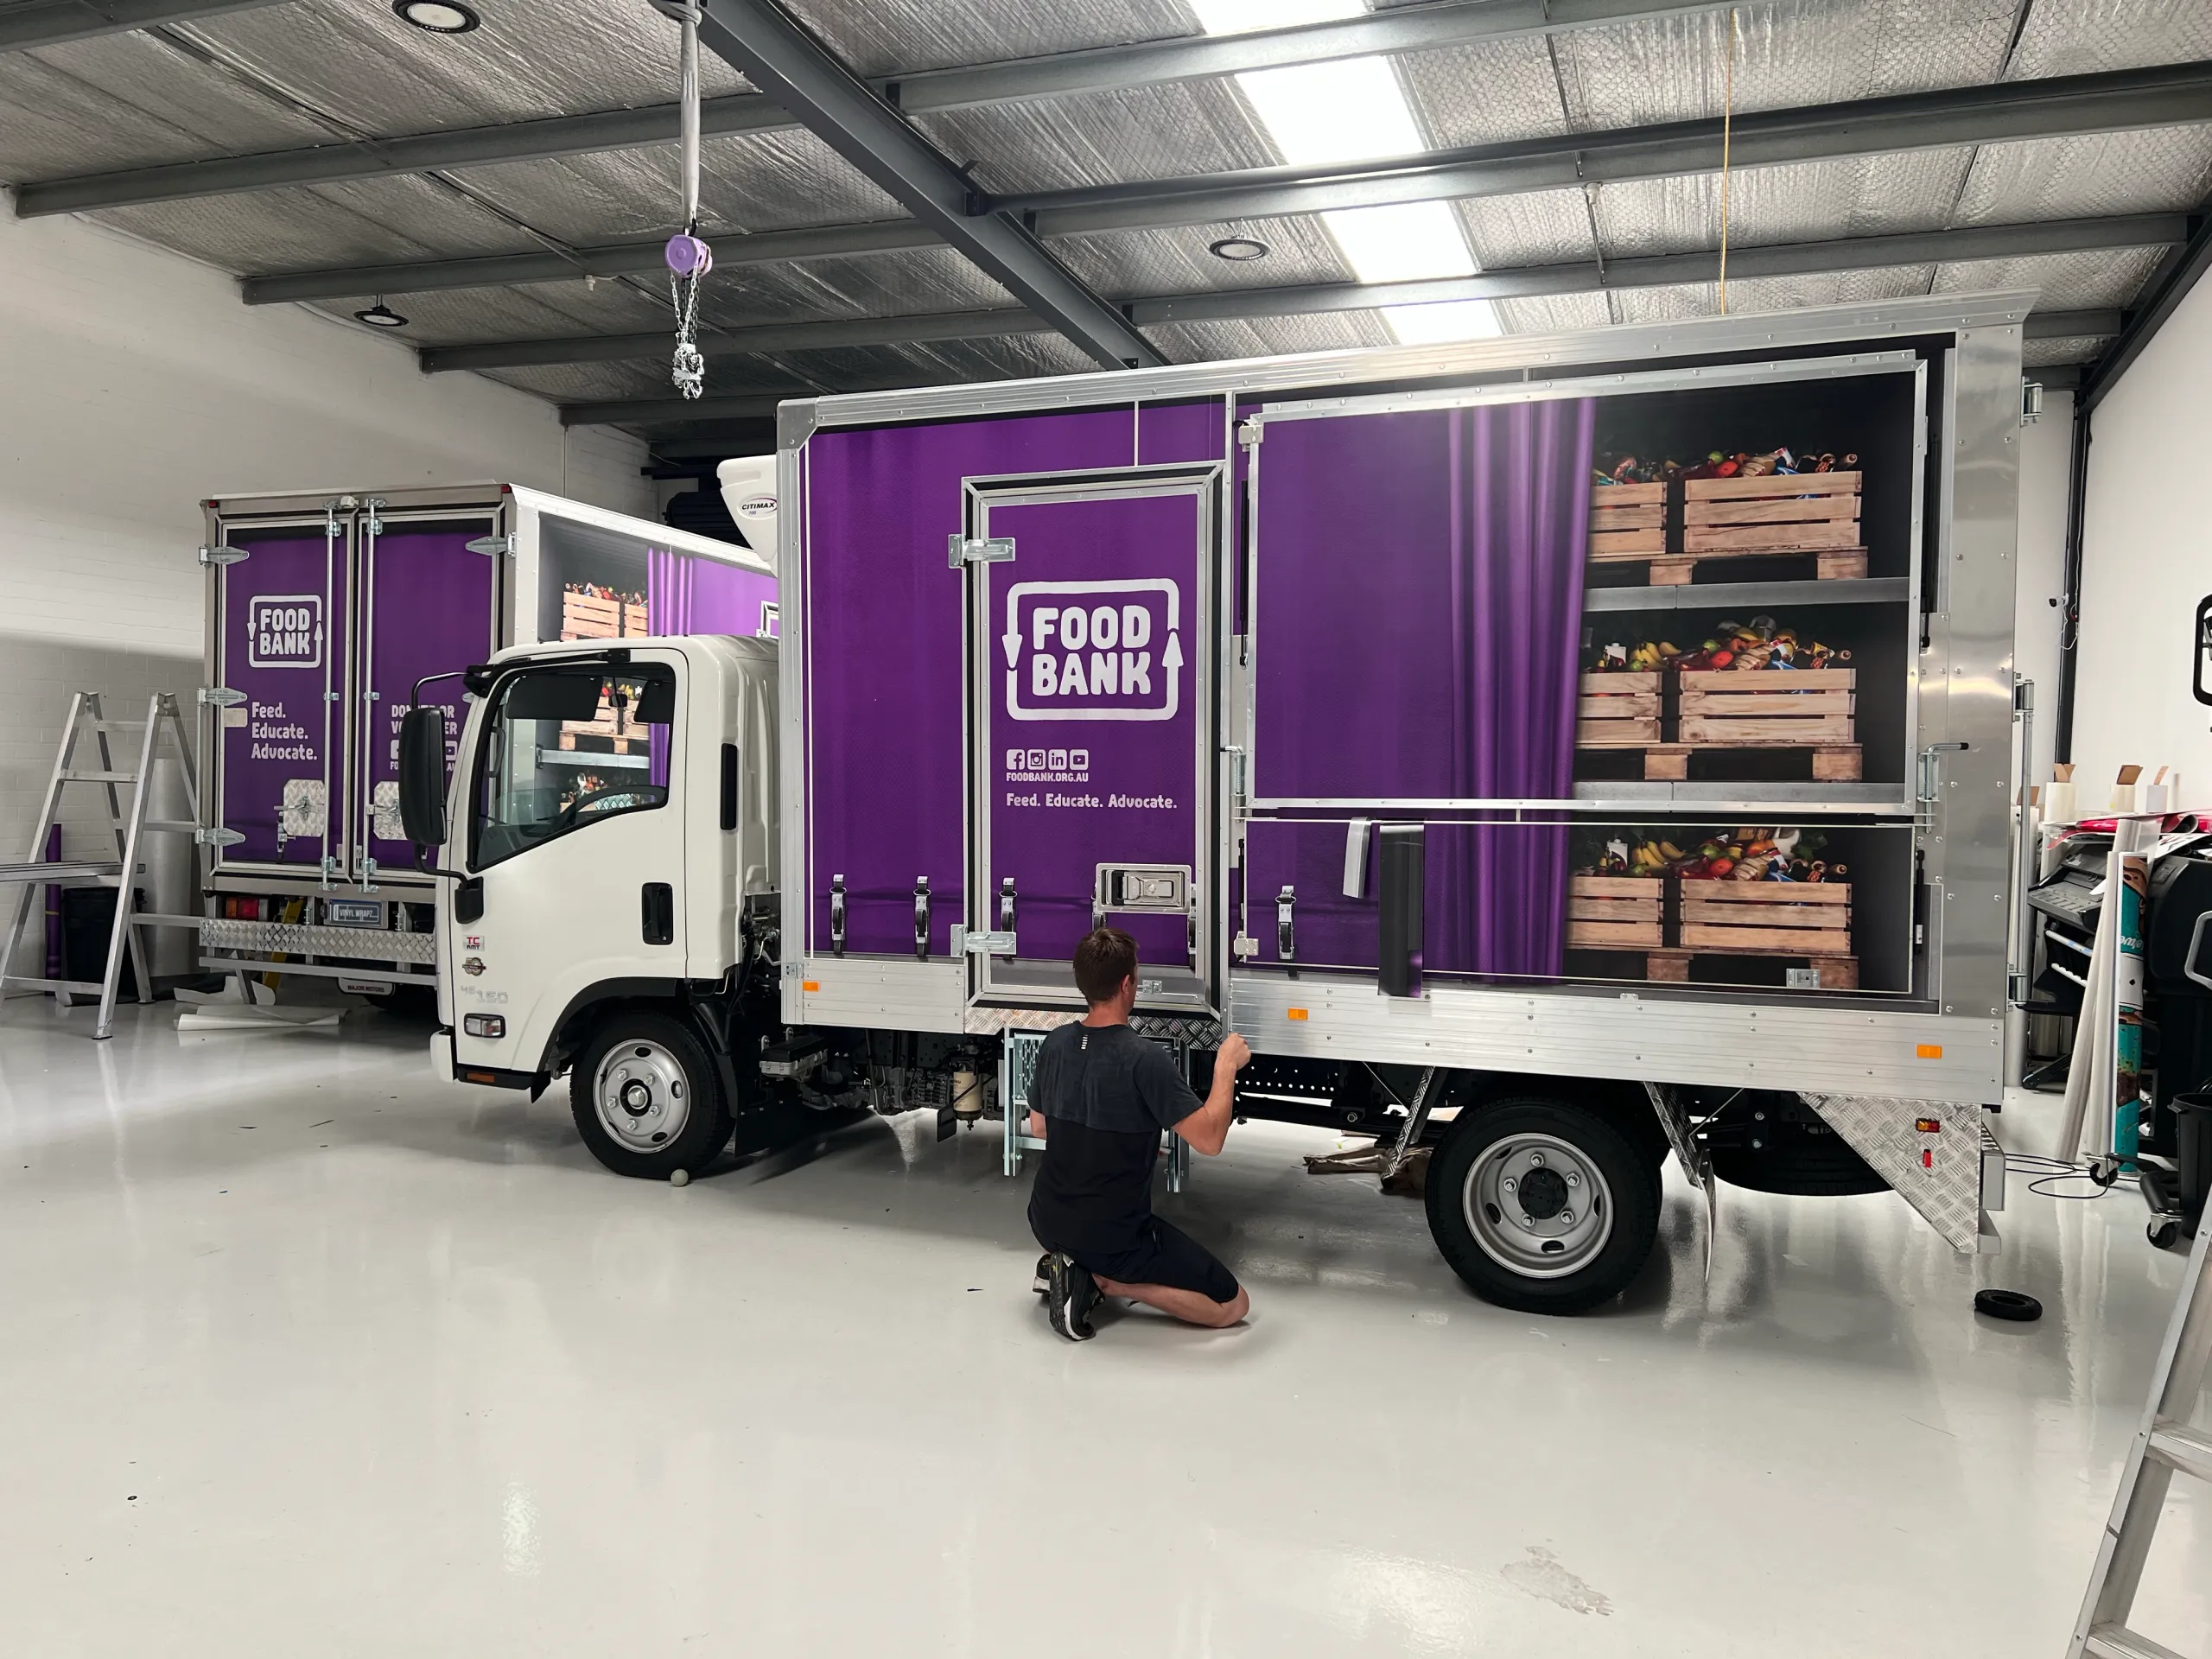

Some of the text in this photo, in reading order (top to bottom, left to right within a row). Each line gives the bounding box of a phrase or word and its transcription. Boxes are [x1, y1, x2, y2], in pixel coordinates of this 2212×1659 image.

[260, 607, 310, 632] FOOD
[1033, 605, 1151, 650] FOOD
[260, 632, 310, 655] BANK
[1033, 652, 1151, 696] BANK
[251, 702, 286, 718] Feed.
[251, 721, 308, 740] Educate.
[251, 742, 318, 760] Advocate.
[1006, 772, 1089, 782] FOODBANK.ORG.AU
[1007, 792, 1177, 809] Feed. Educate. Advocate.
[467, 937, 480, 945] TC
